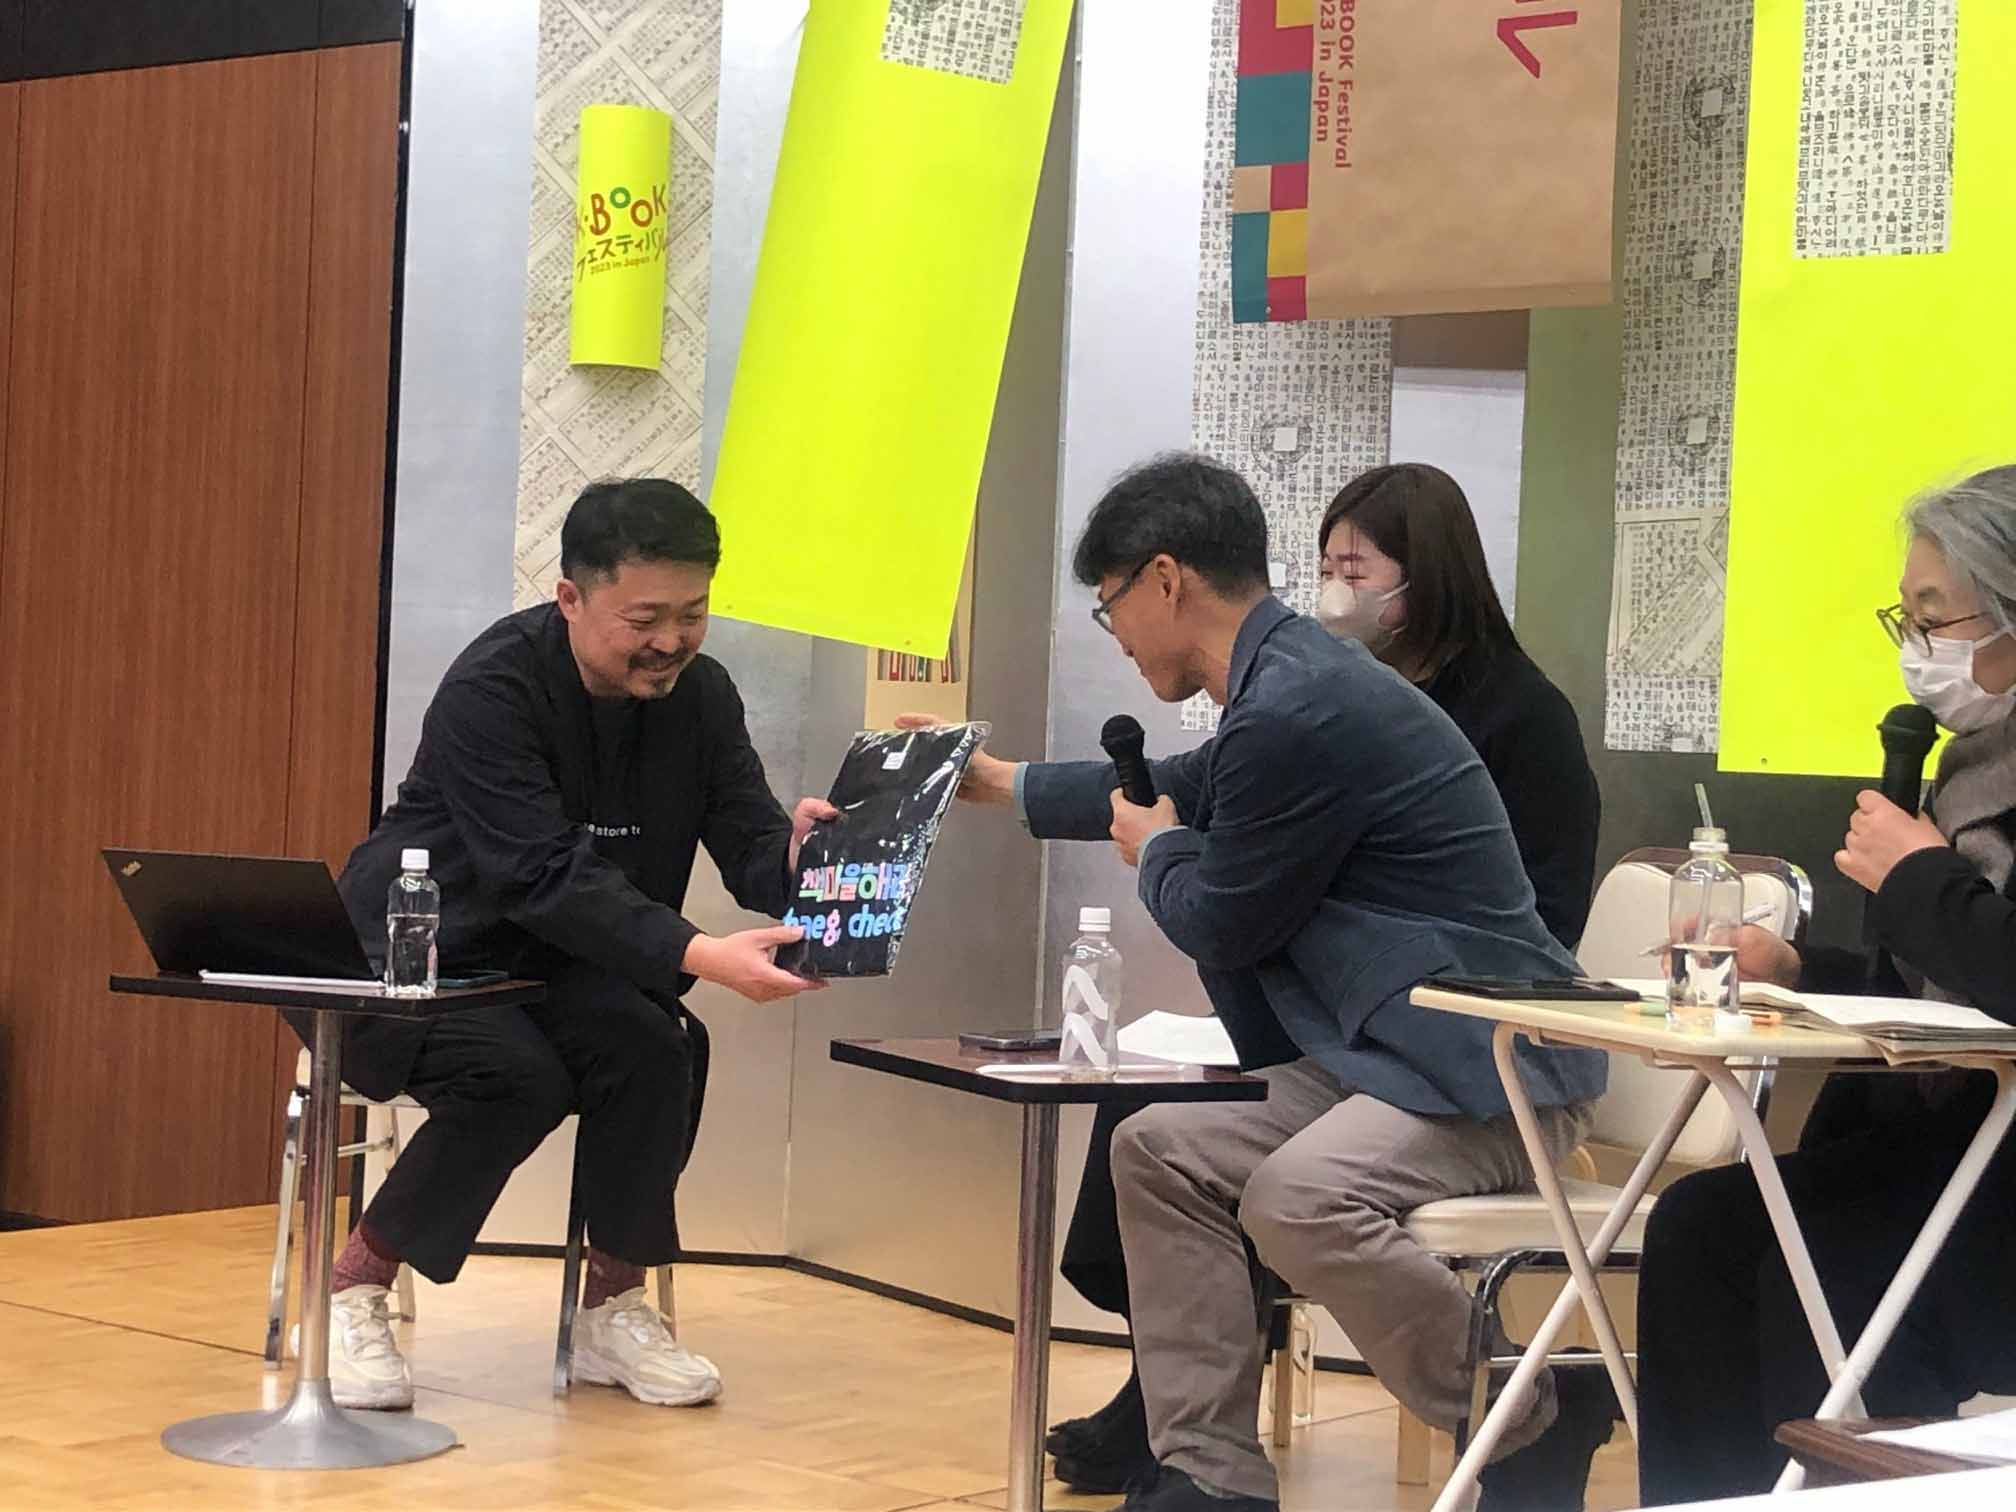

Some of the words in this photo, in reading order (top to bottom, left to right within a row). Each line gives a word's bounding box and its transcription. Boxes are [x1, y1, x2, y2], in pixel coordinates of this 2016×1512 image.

[1320, 0, 1335, 30] 23
[1320, 41, 1336, 61] in
[1313, 71, 1334, 142] Japan
[1335, 80, 1353, 168] Festival
